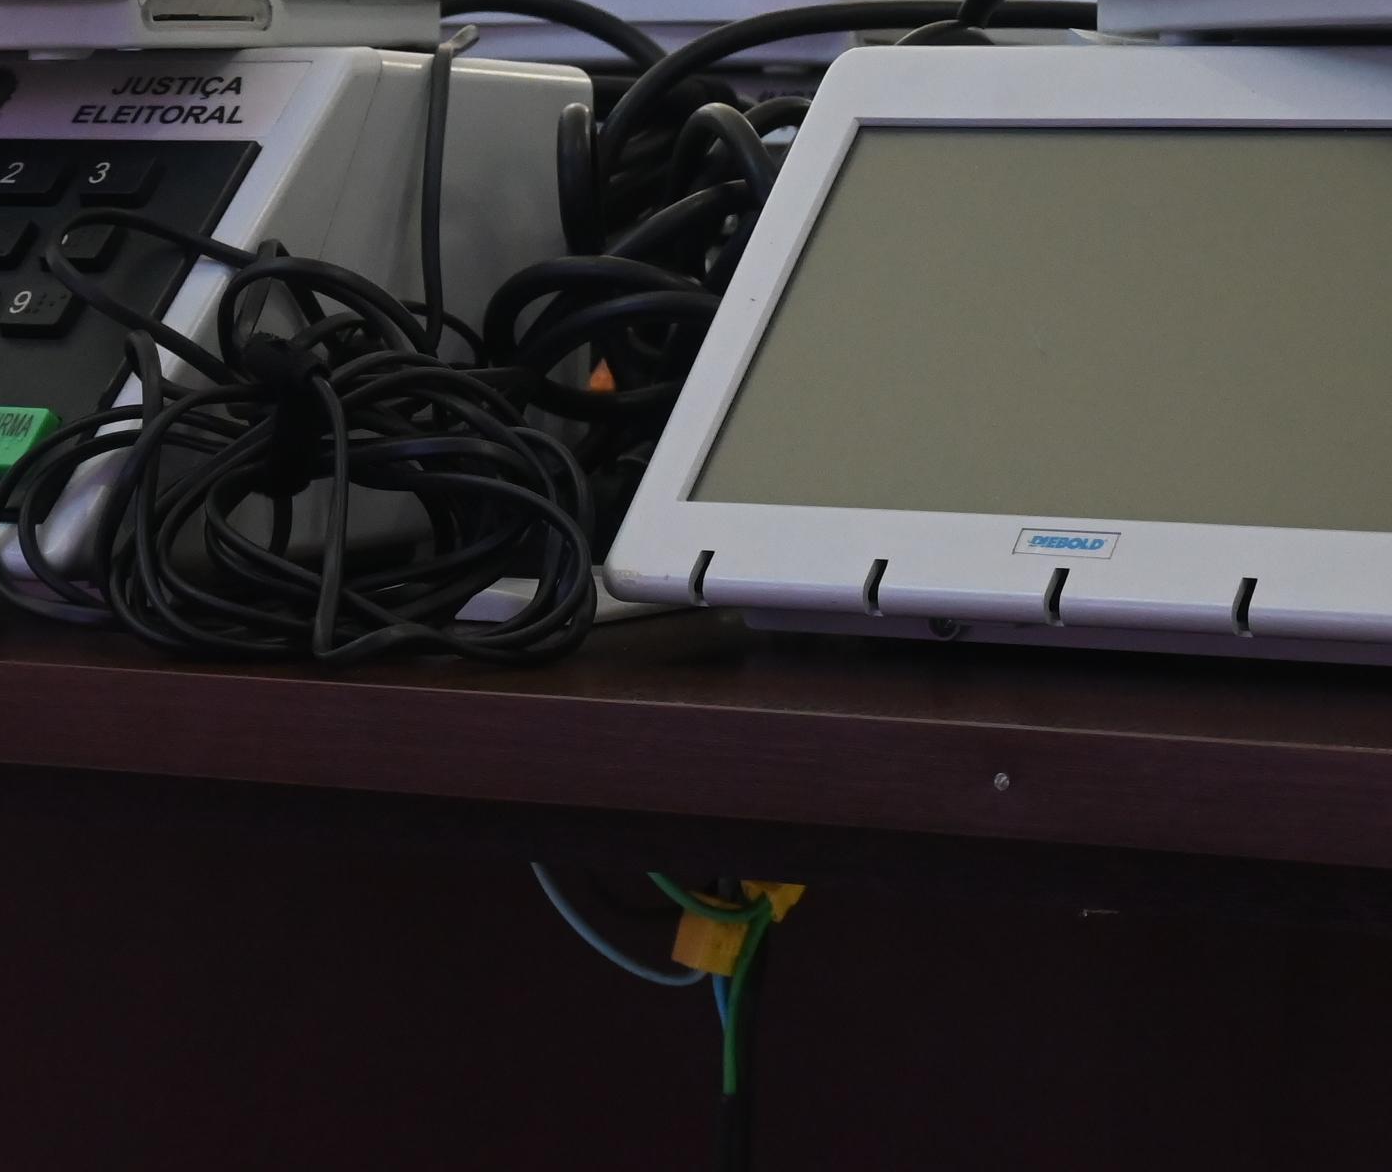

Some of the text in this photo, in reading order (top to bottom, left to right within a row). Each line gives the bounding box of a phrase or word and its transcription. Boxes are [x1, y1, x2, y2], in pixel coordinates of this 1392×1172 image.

[111, 75, 243, 100] JUSTIÇA
[71, 104, 244, 125] ELEITORAL
[0, 162, 24, 184] 2
[88, 162, 111, 184] 3
[9, 290, 32, 314] 9
